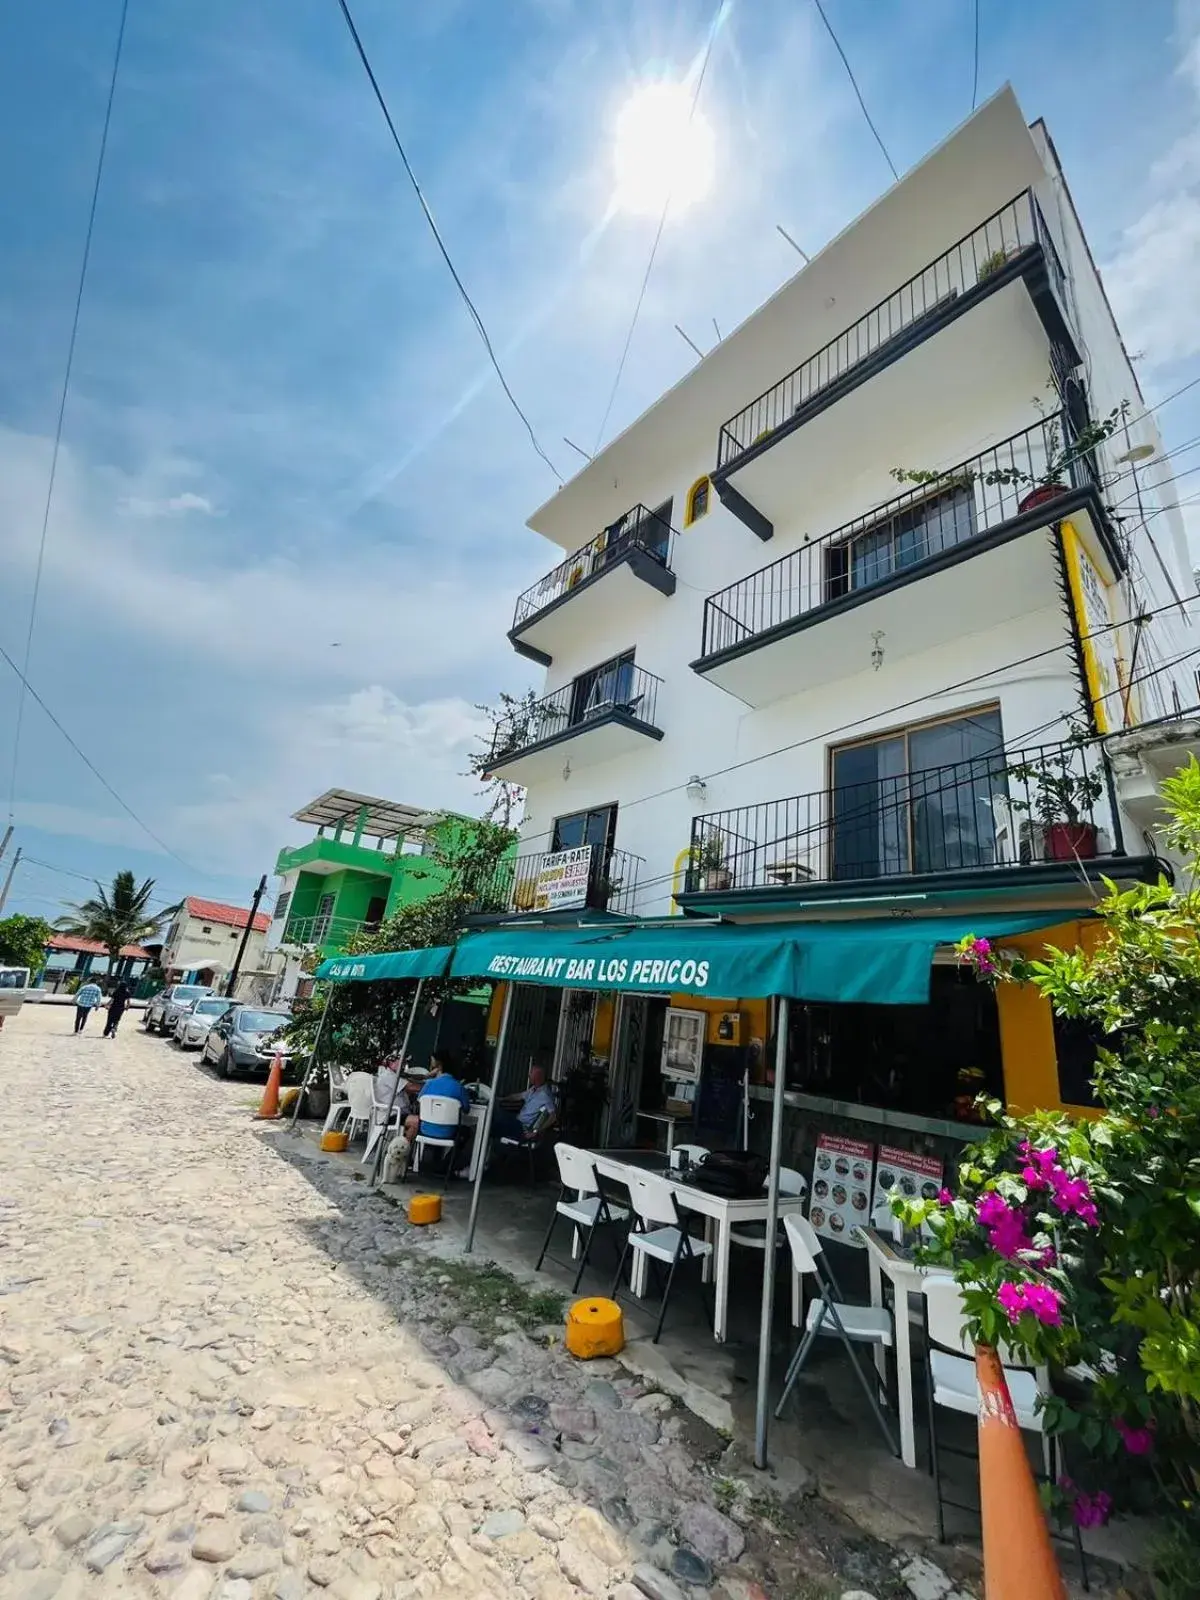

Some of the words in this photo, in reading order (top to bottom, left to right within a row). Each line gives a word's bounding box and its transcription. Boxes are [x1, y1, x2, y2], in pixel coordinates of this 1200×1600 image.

[487, 955, 566, 978] RESTAURANT
[565, 958, 595, 981] BAR
[599, 958, 628, 982] LOS
[629, 959, 709, 987] PERICOS
